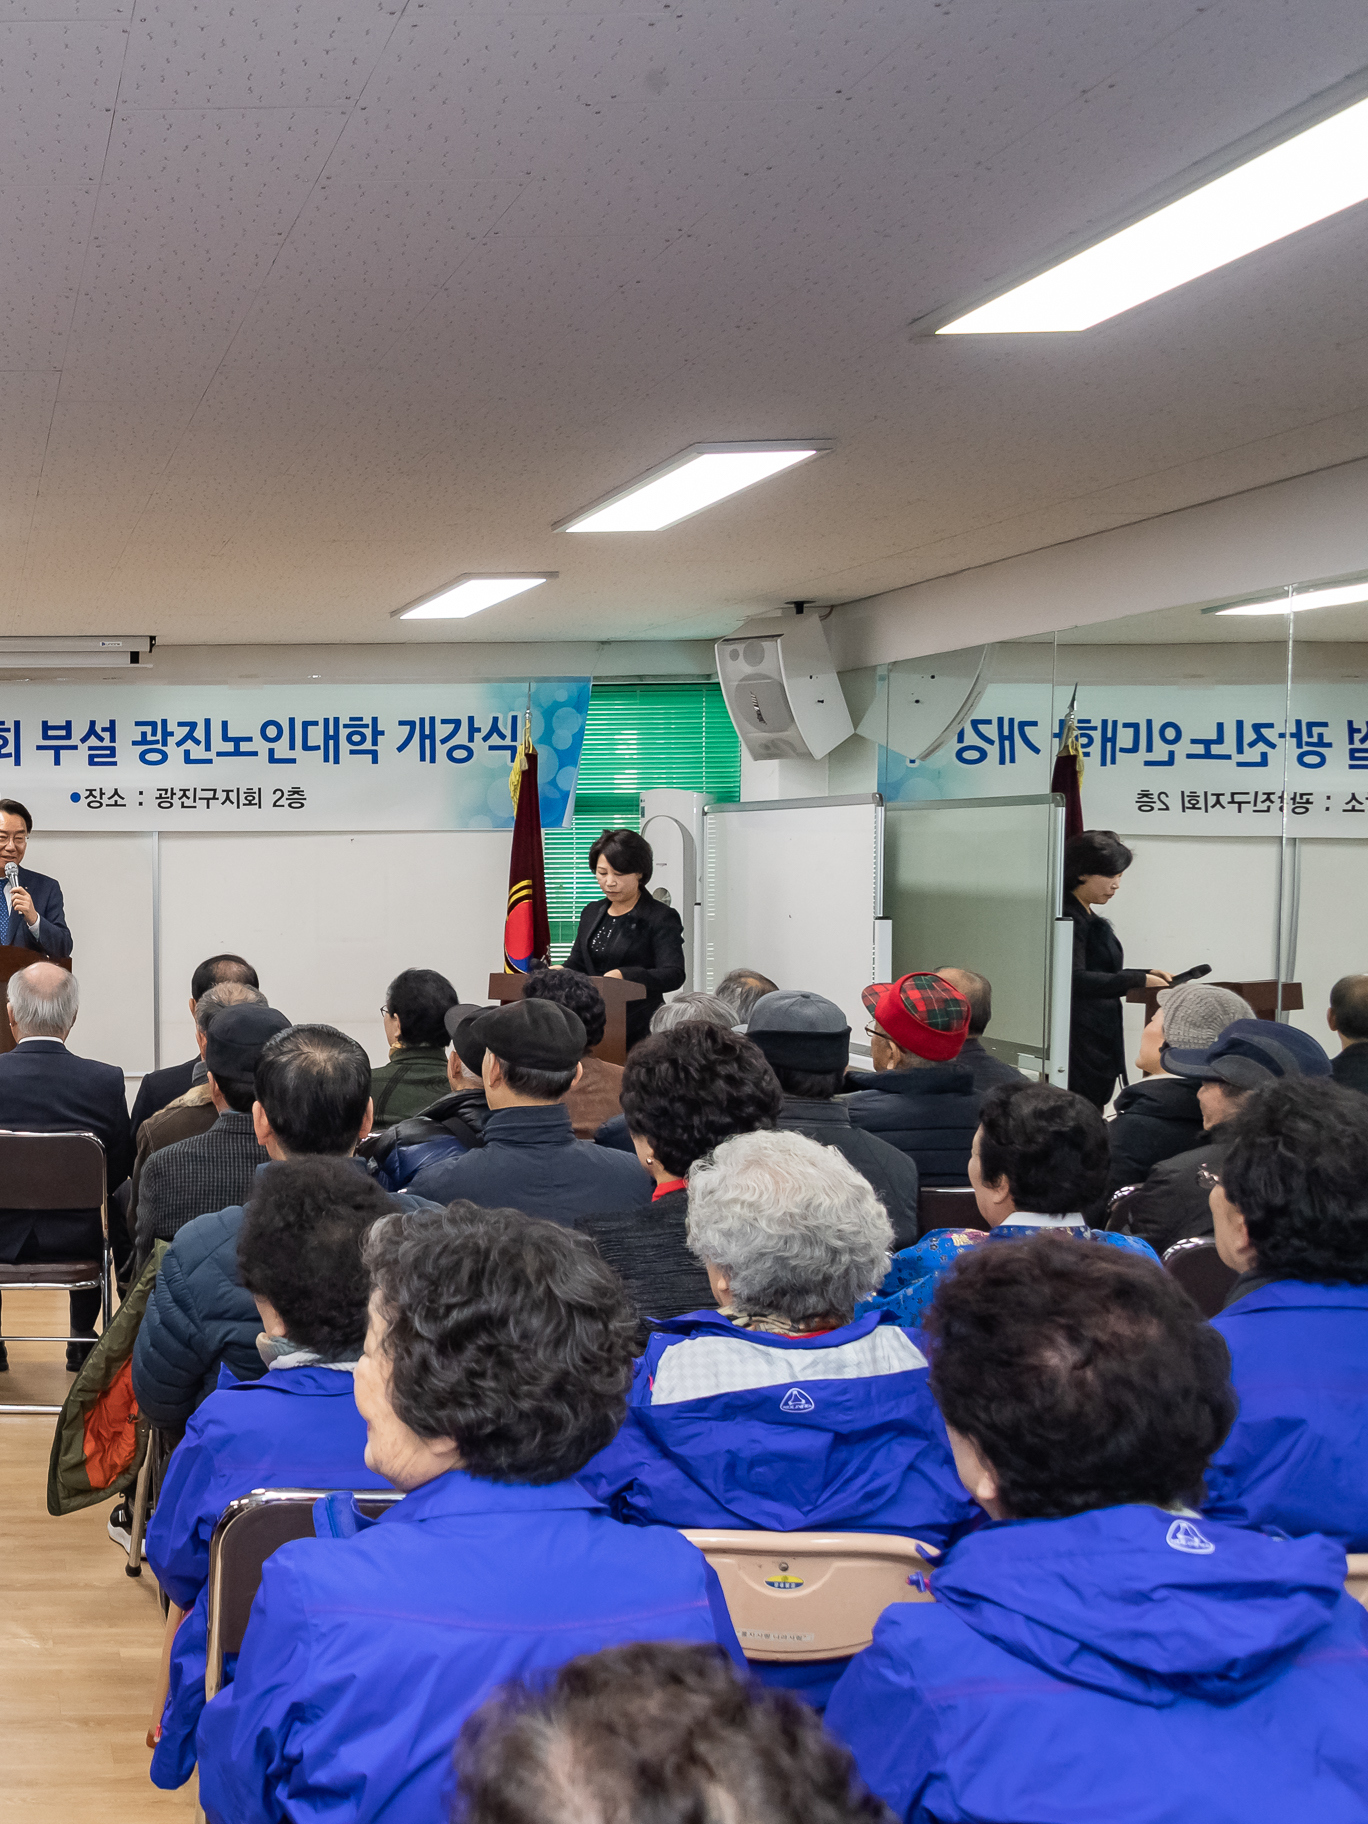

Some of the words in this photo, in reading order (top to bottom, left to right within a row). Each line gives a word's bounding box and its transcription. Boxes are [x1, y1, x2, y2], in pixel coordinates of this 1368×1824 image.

[36, 719, 118, 766] 부설
[131, 716, 385, 766] 광진노인대학
[396, 714, 518, 764] 개강식
[84, 787, 127, 810] 장소
[154, 787, 262, 810] 광진구지회
[272, 786, 307, 810] 2층
